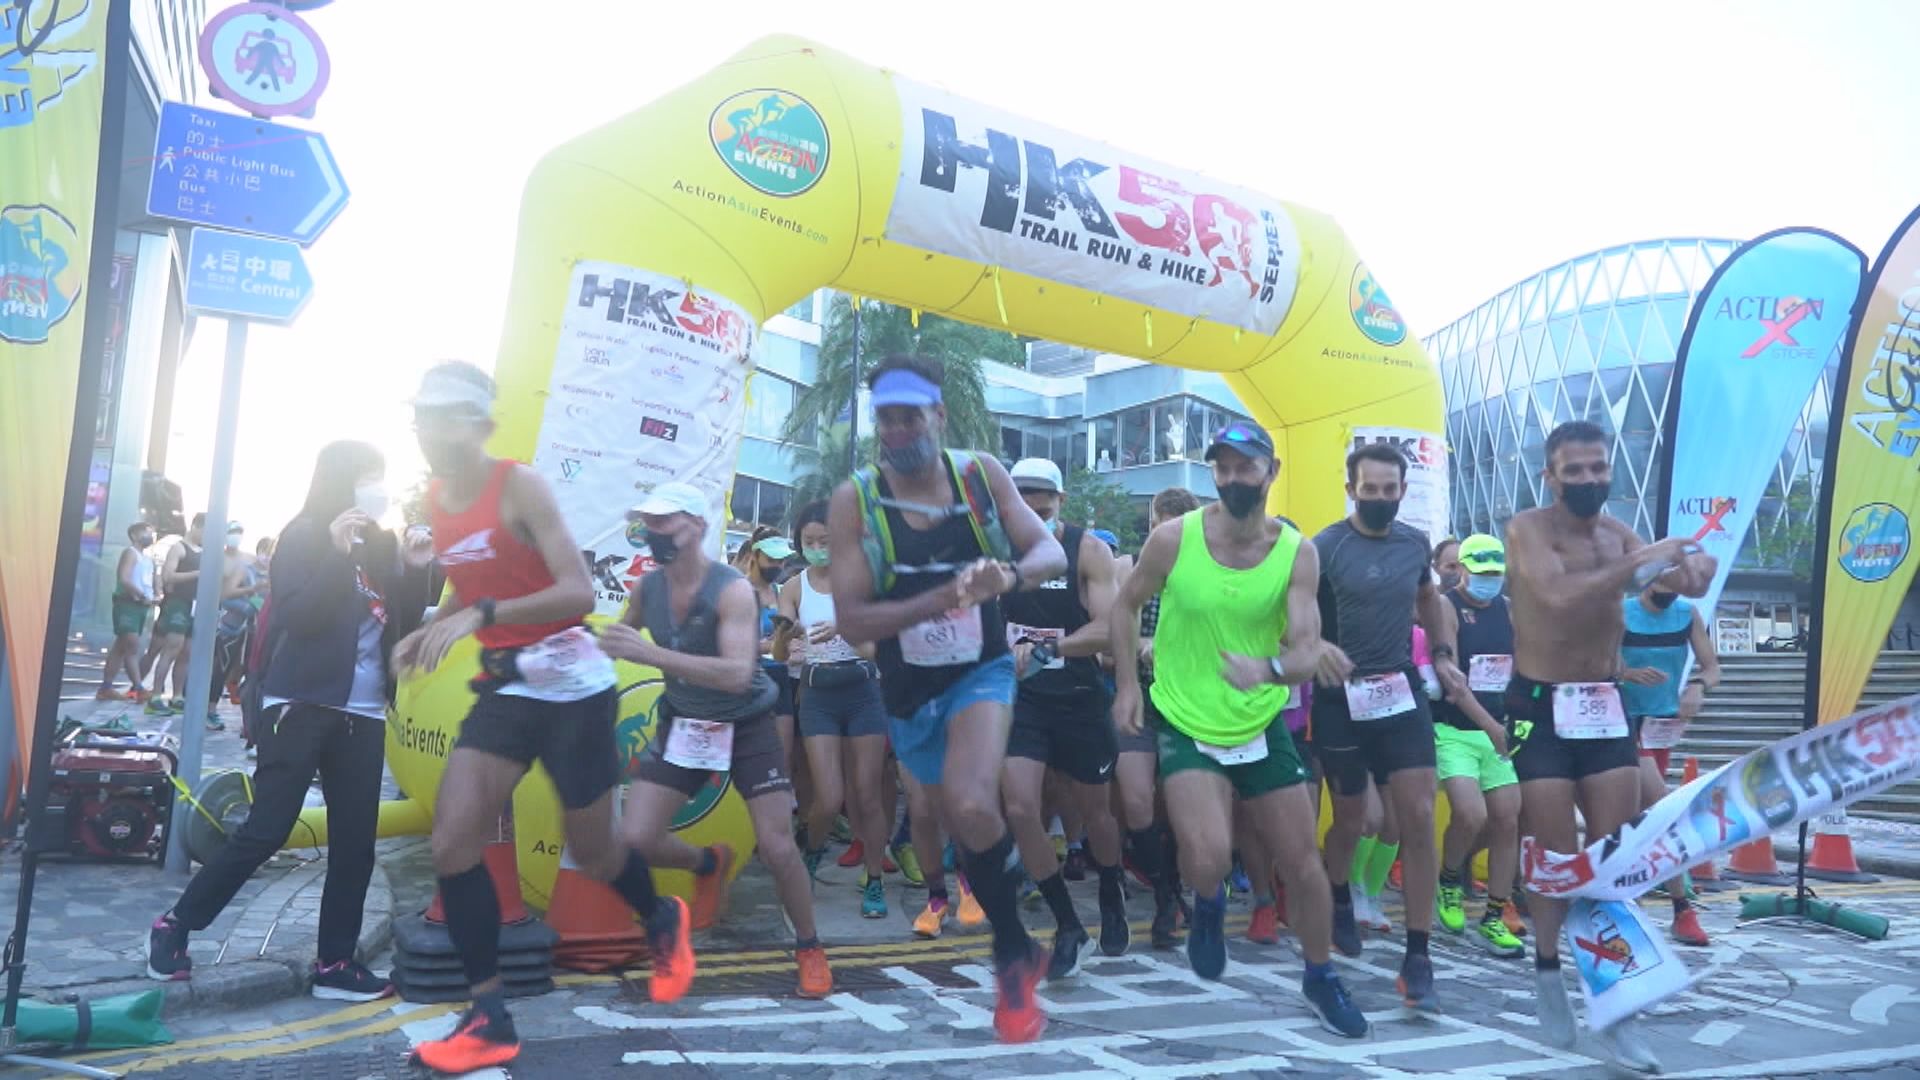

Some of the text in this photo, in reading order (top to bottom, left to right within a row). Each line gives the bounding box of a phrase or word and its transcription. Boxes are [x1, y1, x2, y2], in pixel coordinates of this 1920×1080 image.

[191, 113, 216, 128] Taxi
[186, 129, 225, 149] 的士
[183, 146, 296, 178] Public Light Bus
[734, 149, 797, 180] EVENTS
[179, 180, 207, 194] Bus
[183, 163, 261, 192] 公共小巴
[176, 195, 217, 216] 巴士
[1020, 219, 1207, 285] TRAIL RUN & HIKE
[1259, 207, 1283, 304] SERIES
[241, 278, 301, 300] Central
[627, 316, 722, 353] TRAIL RUN & HIKE
